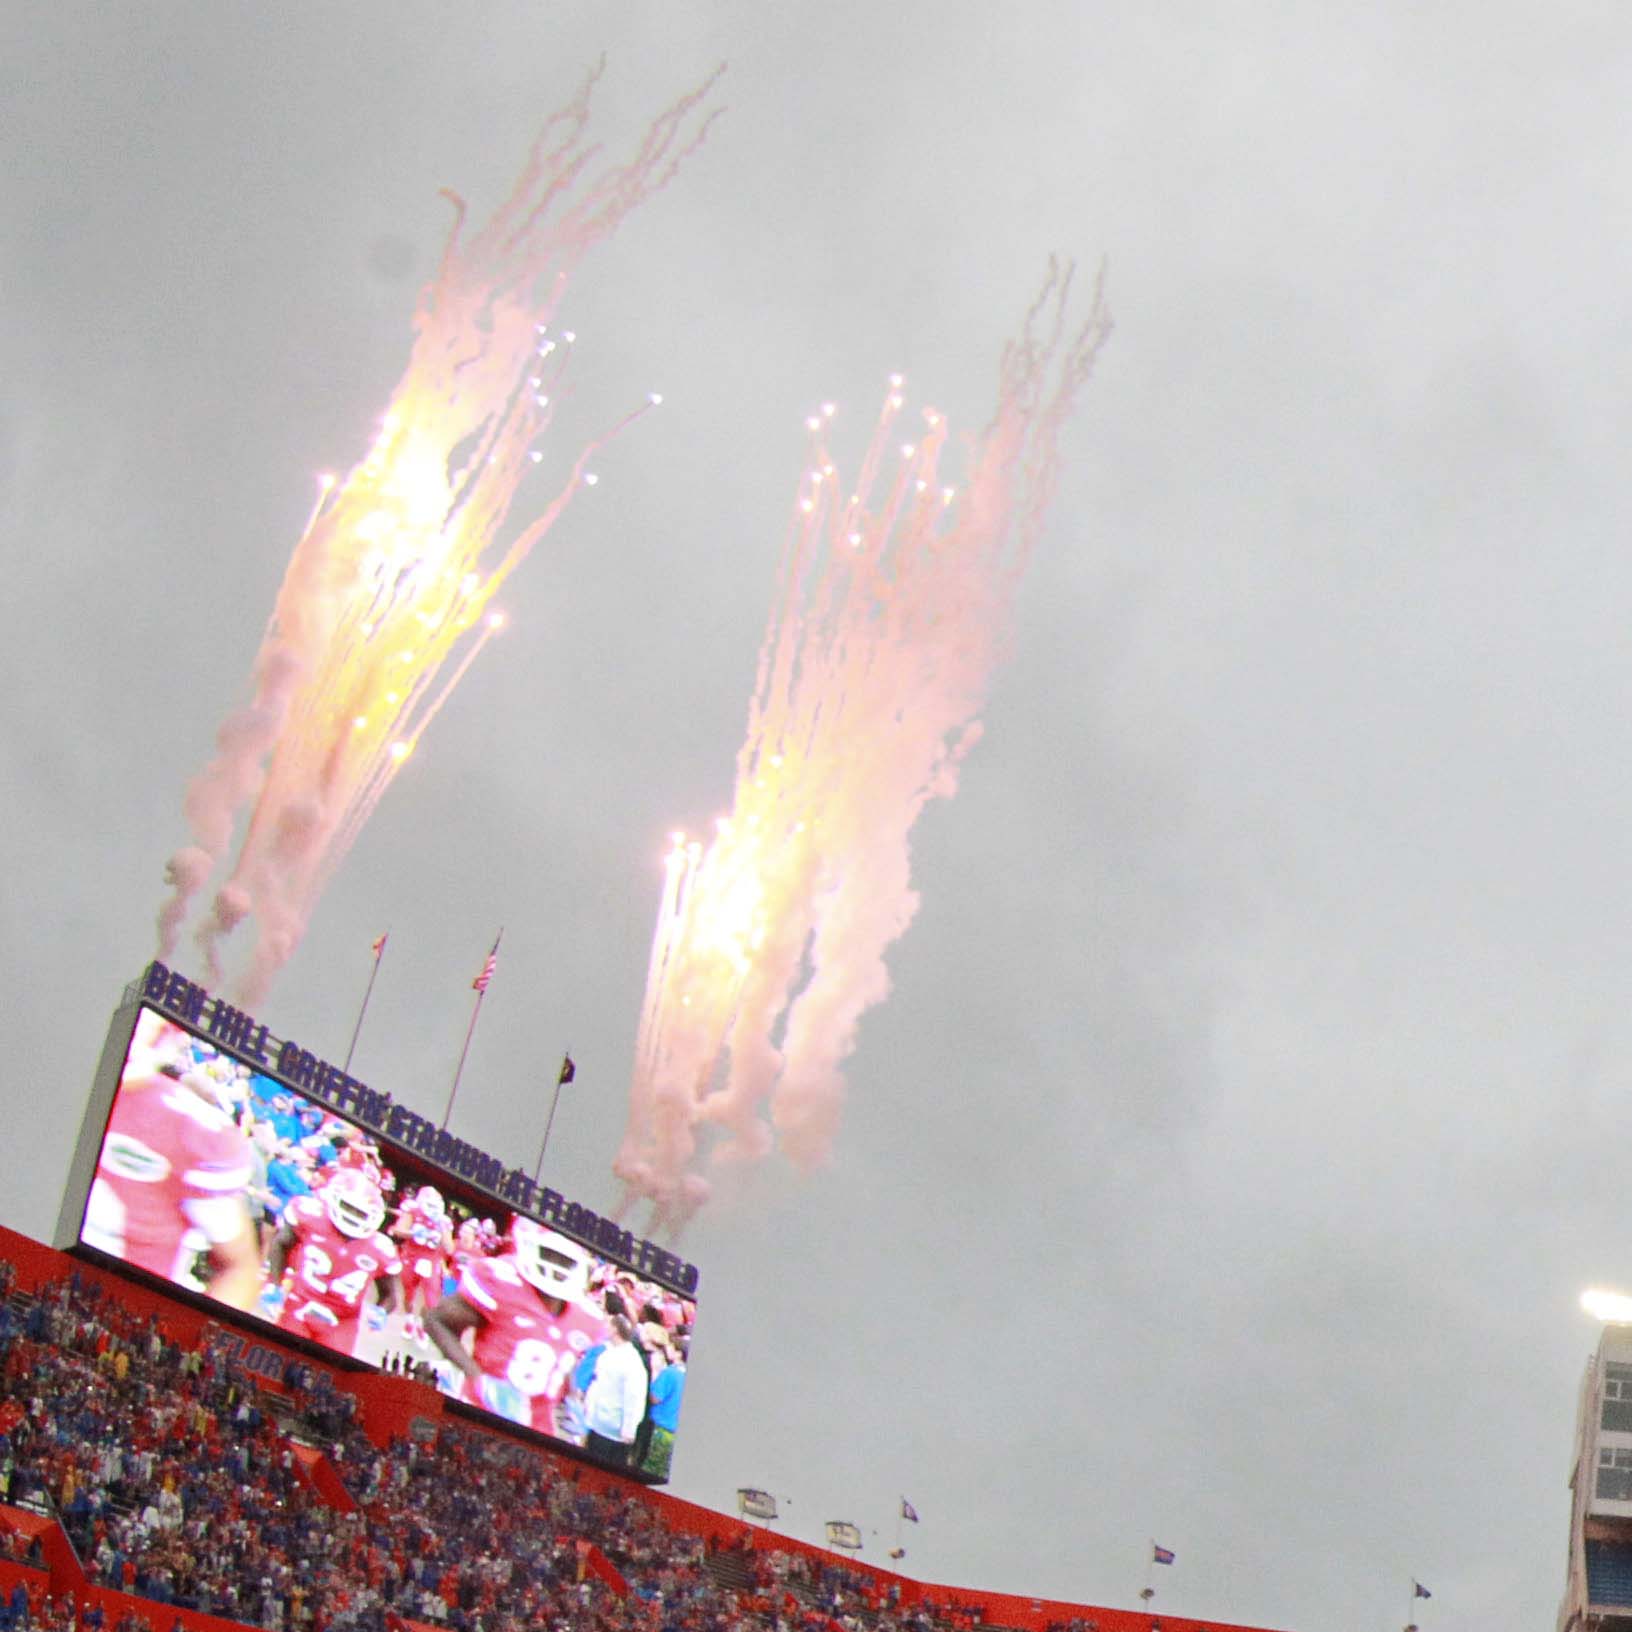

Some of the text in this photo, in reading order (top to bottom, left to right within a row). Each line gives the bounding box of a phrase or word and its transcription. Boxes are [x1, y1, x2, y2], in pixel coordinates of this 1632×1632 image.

[144, 960, 698, 1294] BEN HILL GRIFFIN STADIUM AT FLORIDA FIELD
